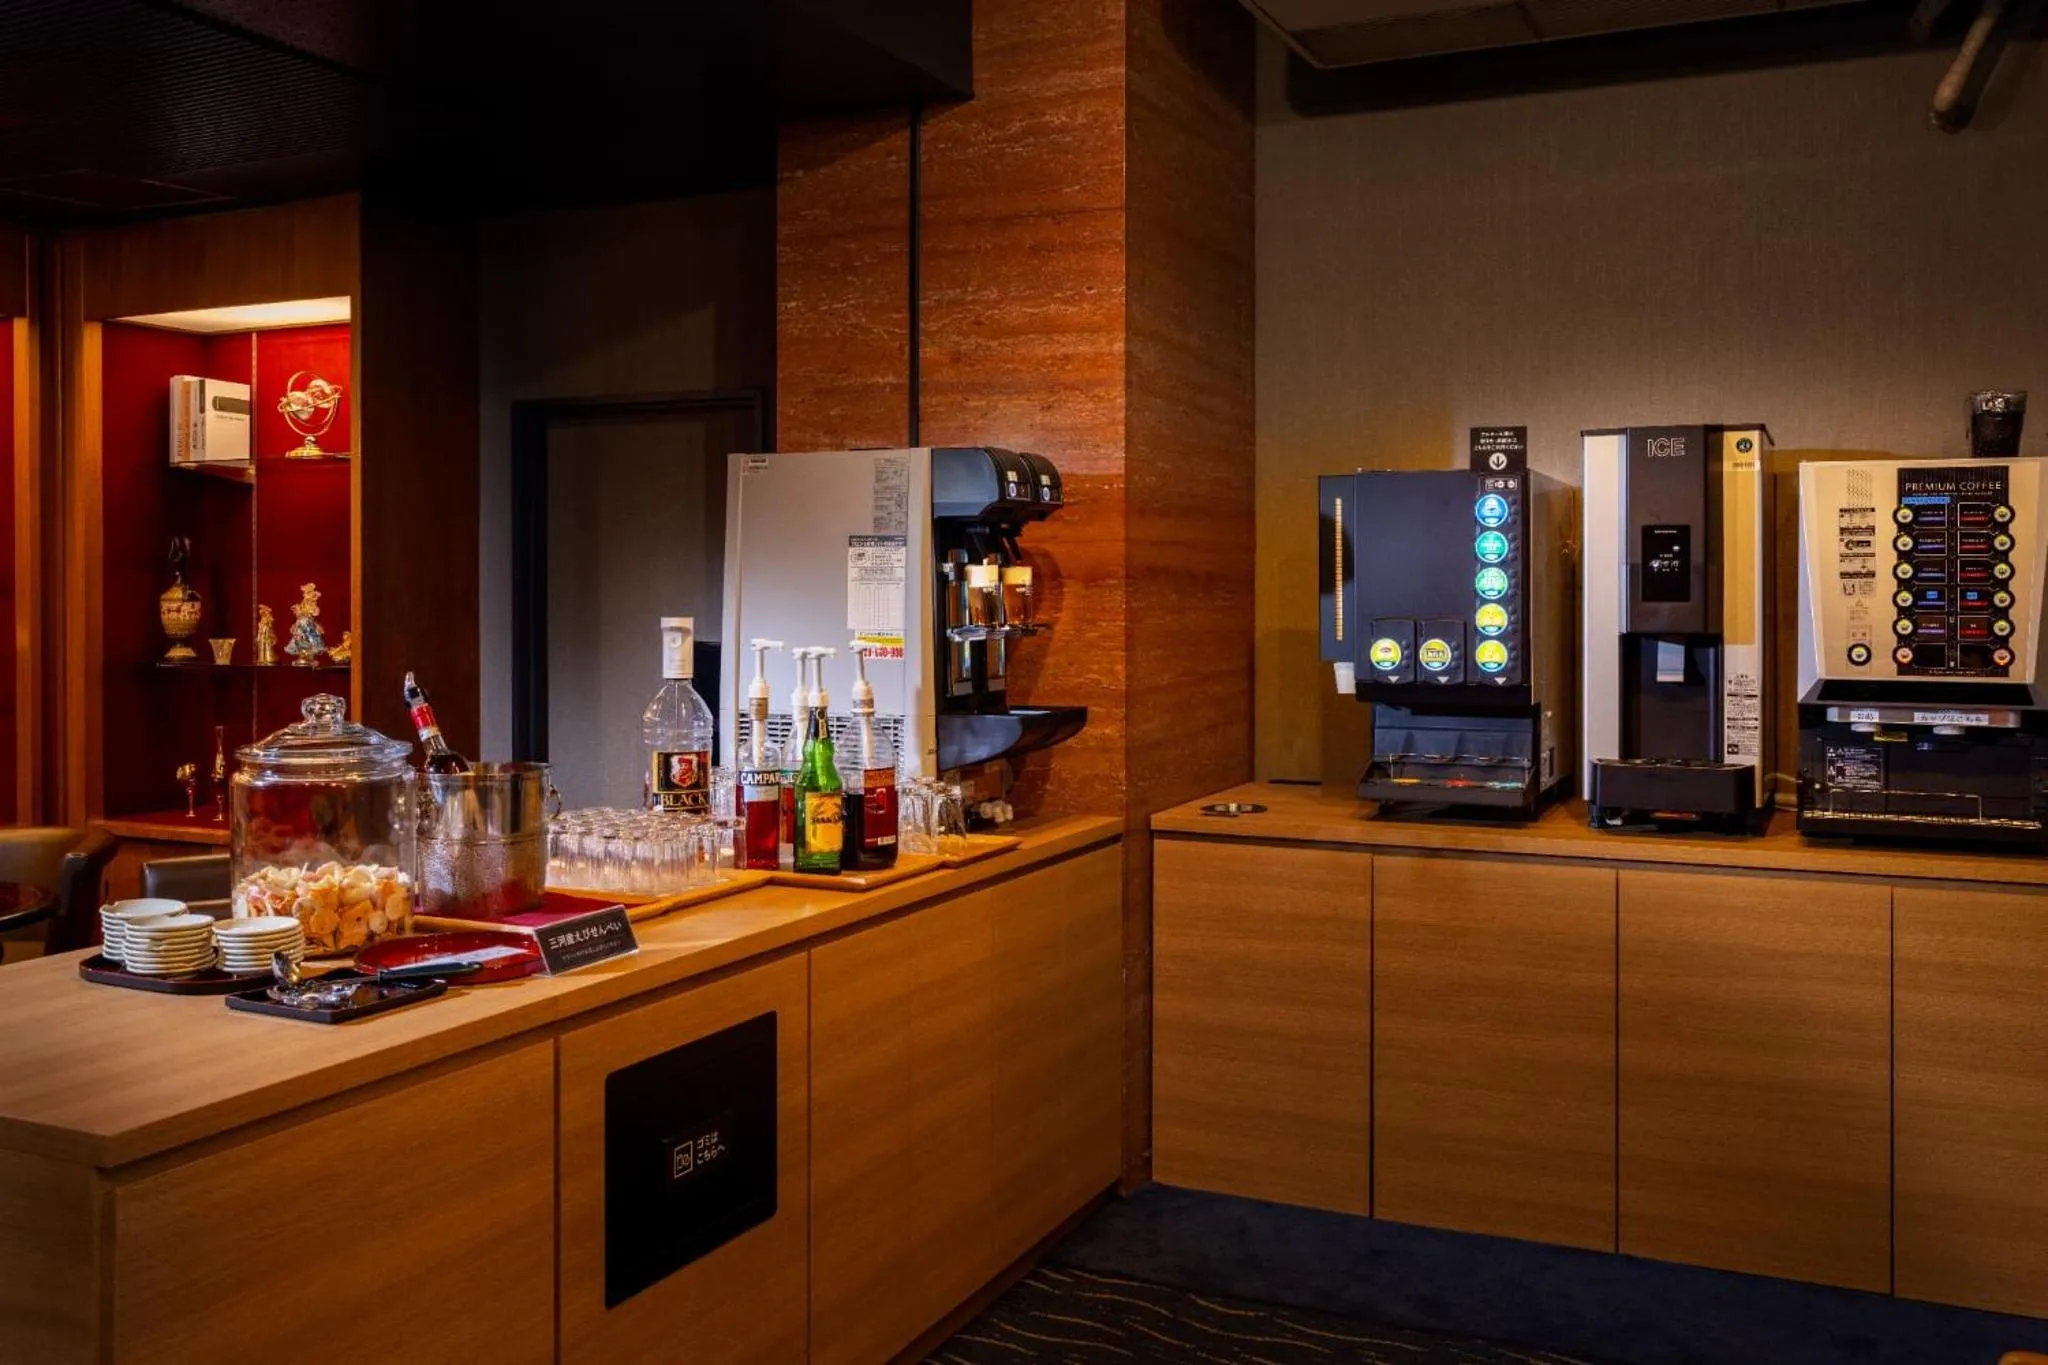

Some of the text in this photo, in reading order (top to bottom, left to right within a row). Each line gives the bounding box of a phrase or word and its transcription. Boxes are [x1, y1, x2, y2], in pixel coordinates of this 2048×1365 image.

[1647, 437, 1686, 457] ICE
[1905, 481, 2001, 492] PREMIUM COFFEE
[661, 792, 706, 806] BLACK
[548, 921, 622, 950] 三河産えびせんべい
[696, 1131, 718, 1149] ゴミは
[696, 1144, 726, 1165] こちらへ
